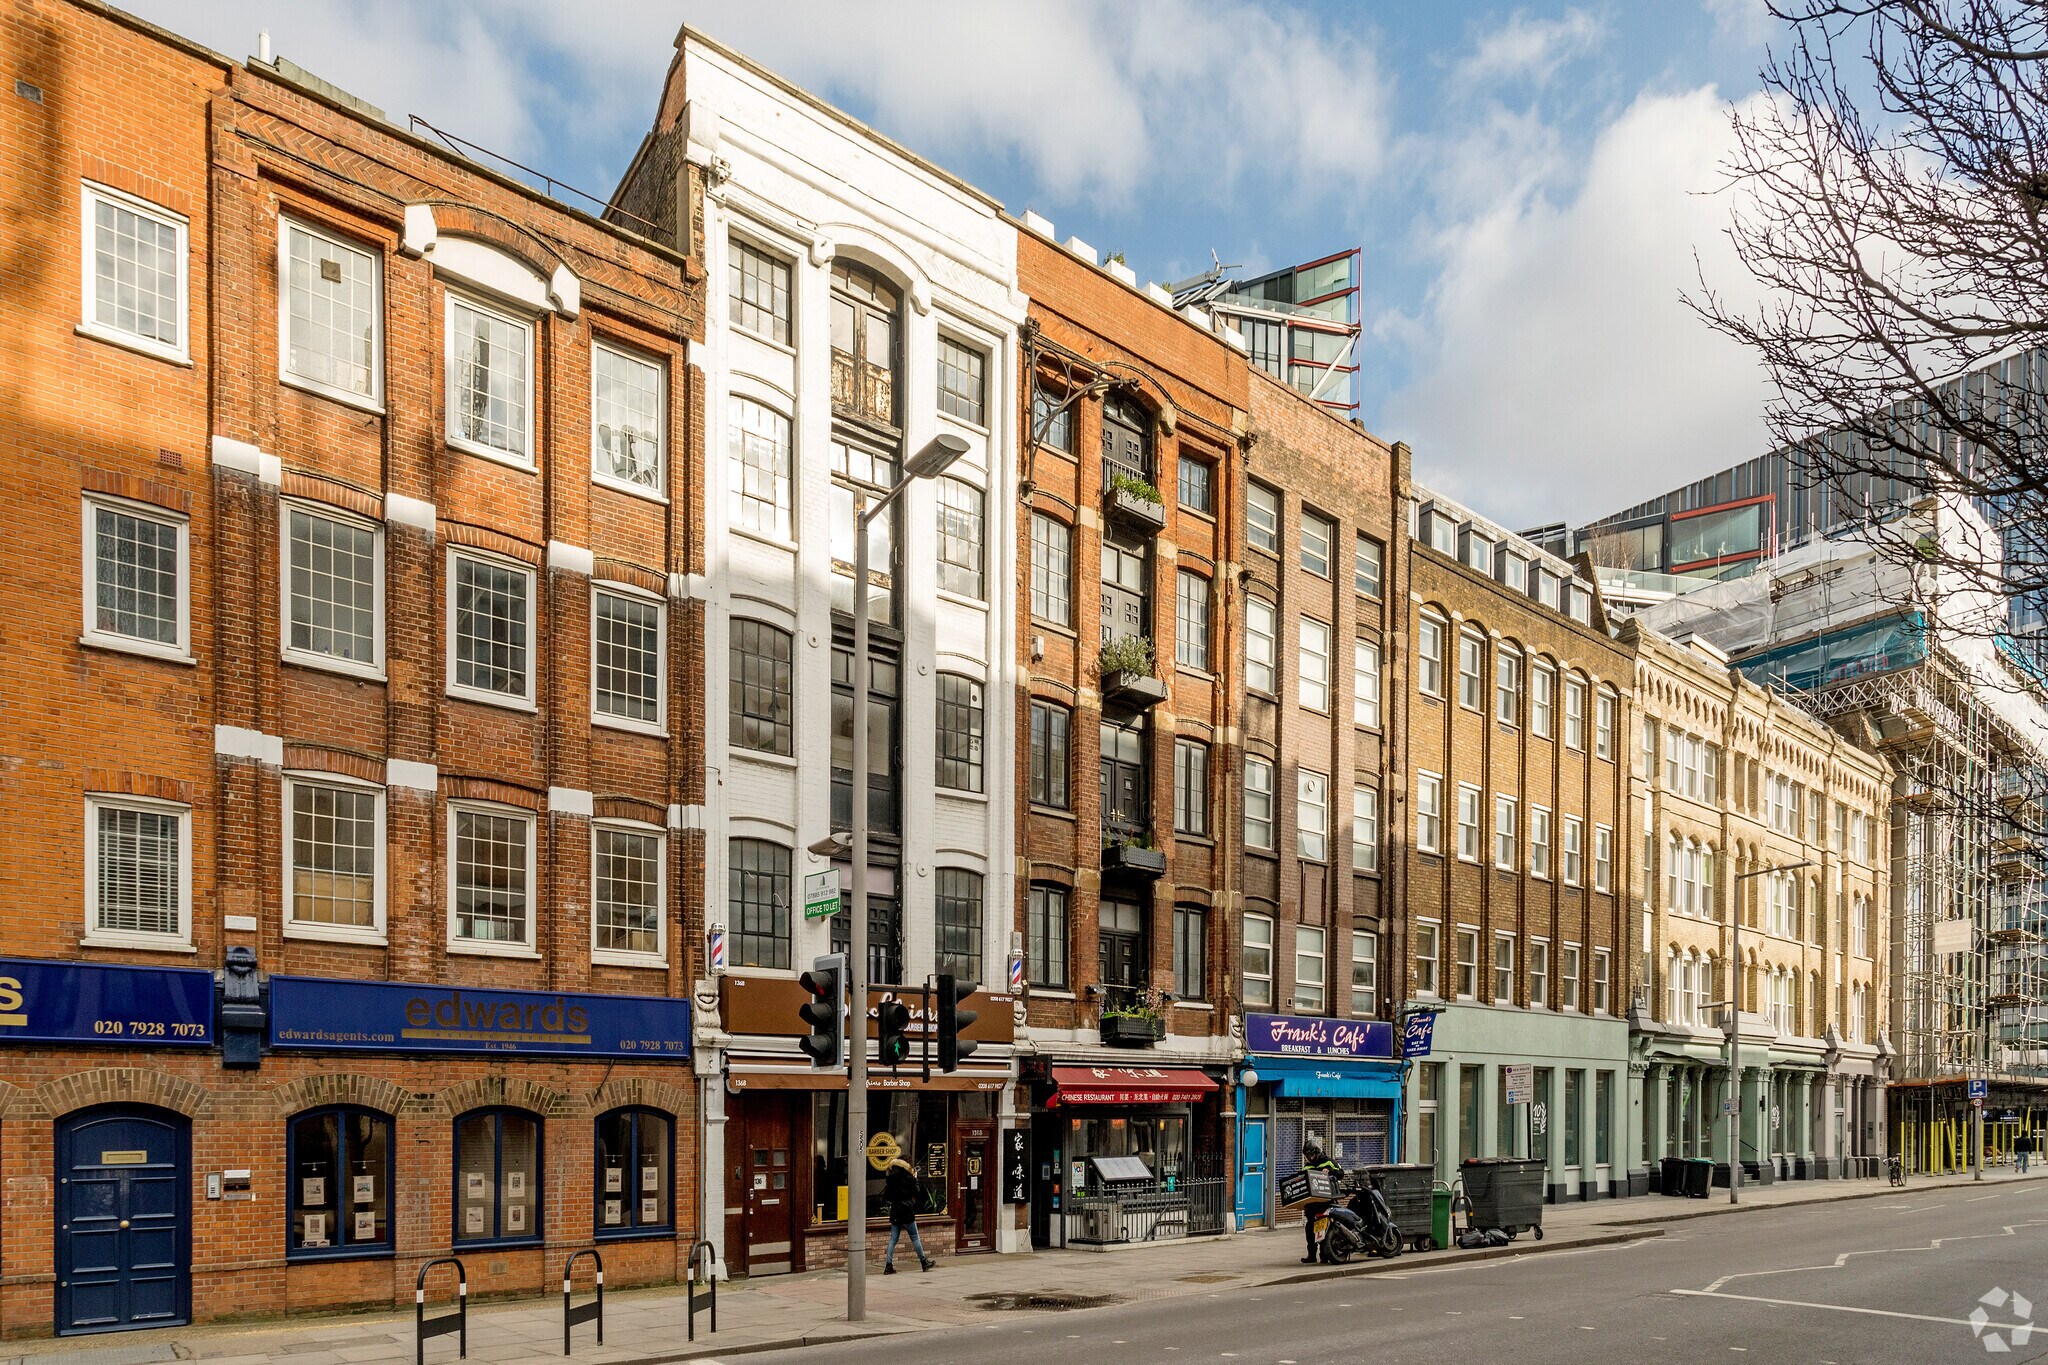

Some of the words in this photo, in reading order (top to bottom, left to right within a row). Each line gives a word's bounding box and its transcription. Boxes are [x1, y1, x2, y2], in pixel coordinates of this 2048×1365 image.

[807, 905, 822, 915] OFFICE
[823, 903, 829, 912] TO
[830, 901, 838, 910] LET
[405, 990, 588, 1033] edwards
[94, 1020, 123, 1034] 020
[129, 1022, 165, 1036] 7928
[171, 1023, 205, 1037] 7073
[1270, 1020, 1327, 1043] Frank's
[279, 1028, 395, 1042] edwardsagents.com
[501, 1042, 517, 1050] 1946
[620, 1041, 636, 1049] 020
[640, 1041, 660, 1050] 7928
[664, 1041, 684, 1050] 7073
[1281, 1044, 1311, 1053] BREAKFAST
[1327, 1047, 1350, 1055] LUNCHES
[883, 1079, 898, 1087] Barber
[898, 1080, 911, 1088] Shop
[1972, 1081, 1982, 1091] P
